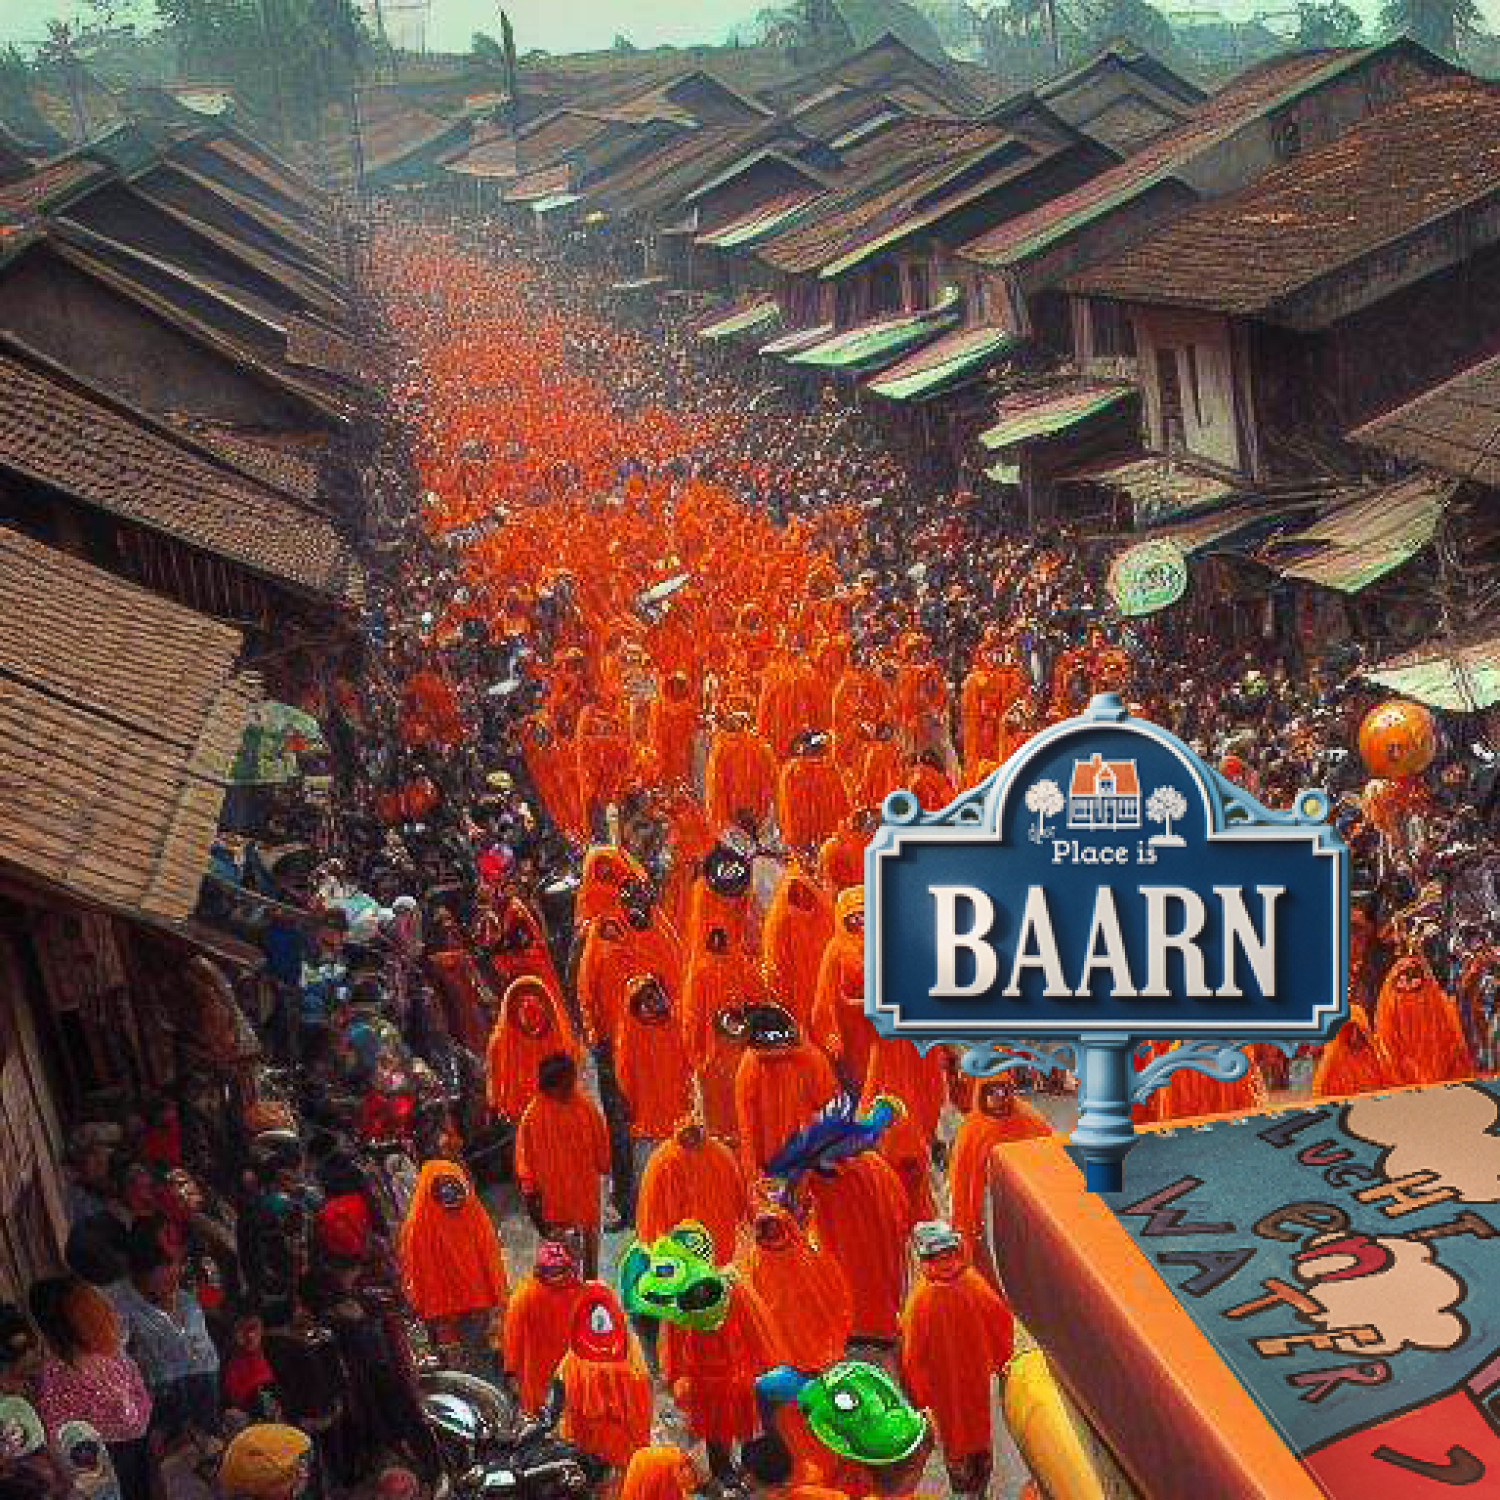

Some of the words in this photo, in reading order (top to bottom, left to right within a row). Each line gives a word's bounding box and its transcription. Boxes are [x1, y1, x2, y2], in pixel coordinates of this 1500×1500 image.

[1051, 840, 1129, 864] Place
[1136, 840, 1158, 864] is
[928, 885, 1287, 997] BAARN
[1117, 1173, 1392, 1402] WATER
